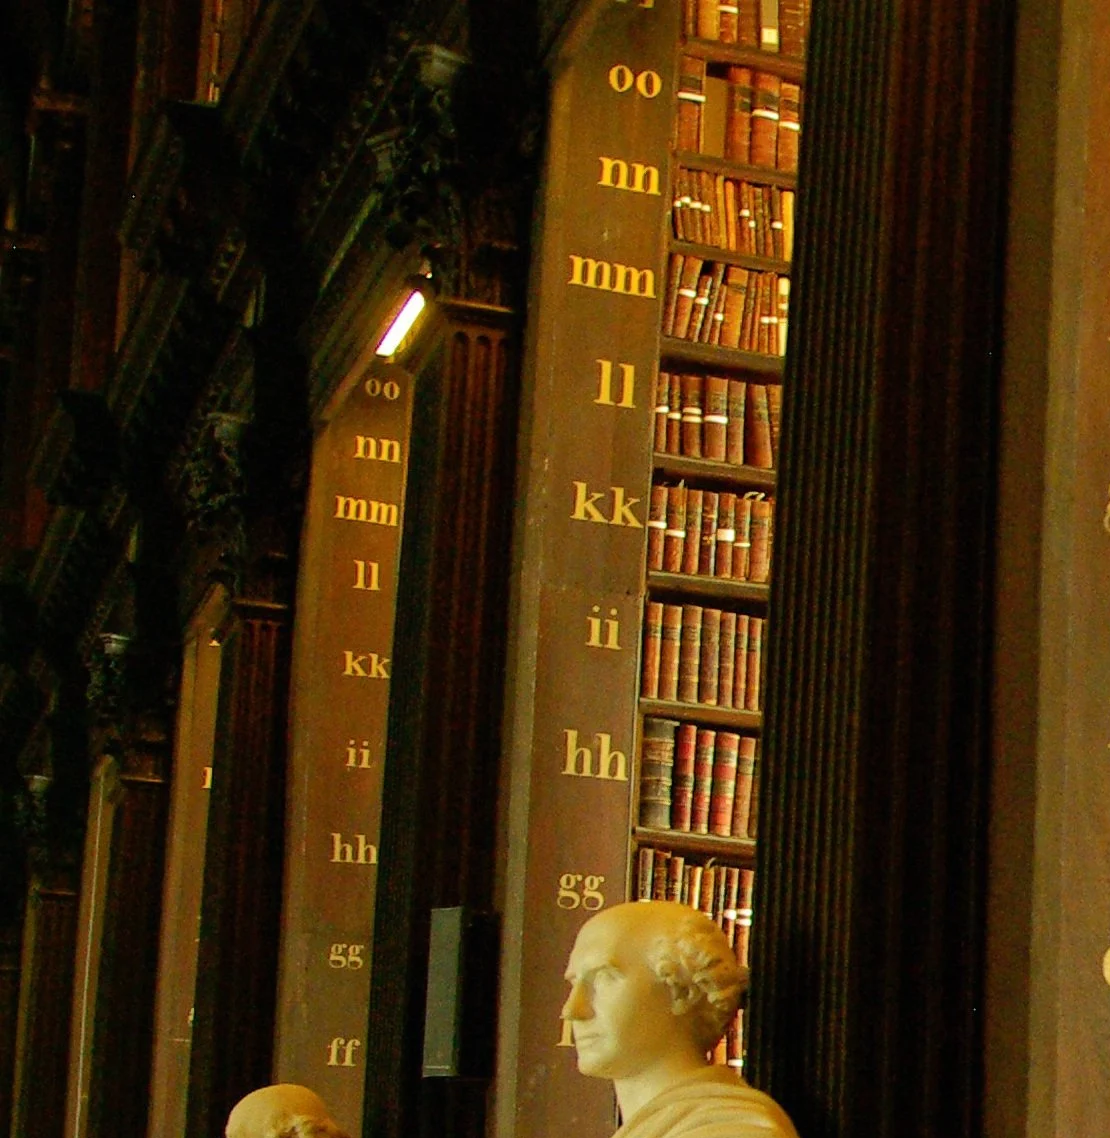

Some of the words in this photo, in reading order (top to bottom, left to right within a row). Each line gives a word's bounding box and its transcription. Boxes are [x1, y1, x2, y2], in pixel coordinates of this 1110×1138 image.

[609, 65, 662, 98] oo
[598, 157, 661, 196] nn
[569, 255, 656, 298] mm
[365, 379, 401, 401] oo
[594, 359, 636, 409] ll
[355, 435, 400, 463] nn
[336, 496, 399, 527] mm
[570, 481, 644, 529] kk
[354, 560, 380, 591] ll
[586, 605, 621, 650] ii
[343, 650, 390, 679] kk
[346, 739, 371, 769] ii
[563, 730, 628, 782] hh
[331, 833, 378, 864] hh
[556, 872, 606, 911] gg
[329, 943, 364, 968] gg
[327, 1037, 361, 1067] ff
